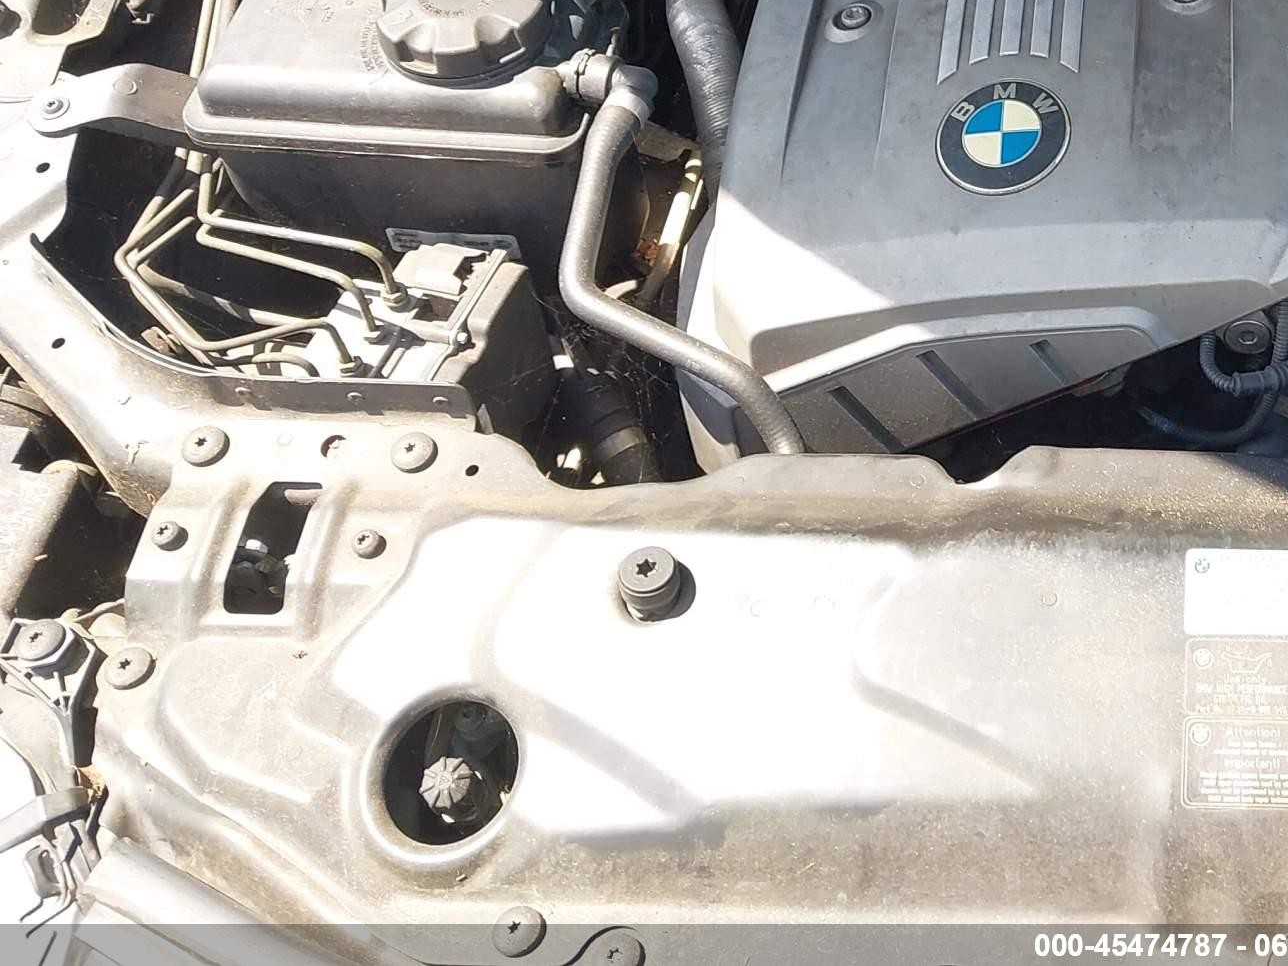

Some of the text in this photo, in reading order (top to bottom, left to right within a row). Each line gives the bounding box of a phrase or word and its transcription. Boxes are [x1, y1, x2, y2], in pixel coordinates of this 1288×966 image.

[951, 83, 1060, 123] BMW
[1225, 727, 1280, 738] Attention!
[1224, 758, 1280, 770] Important!
